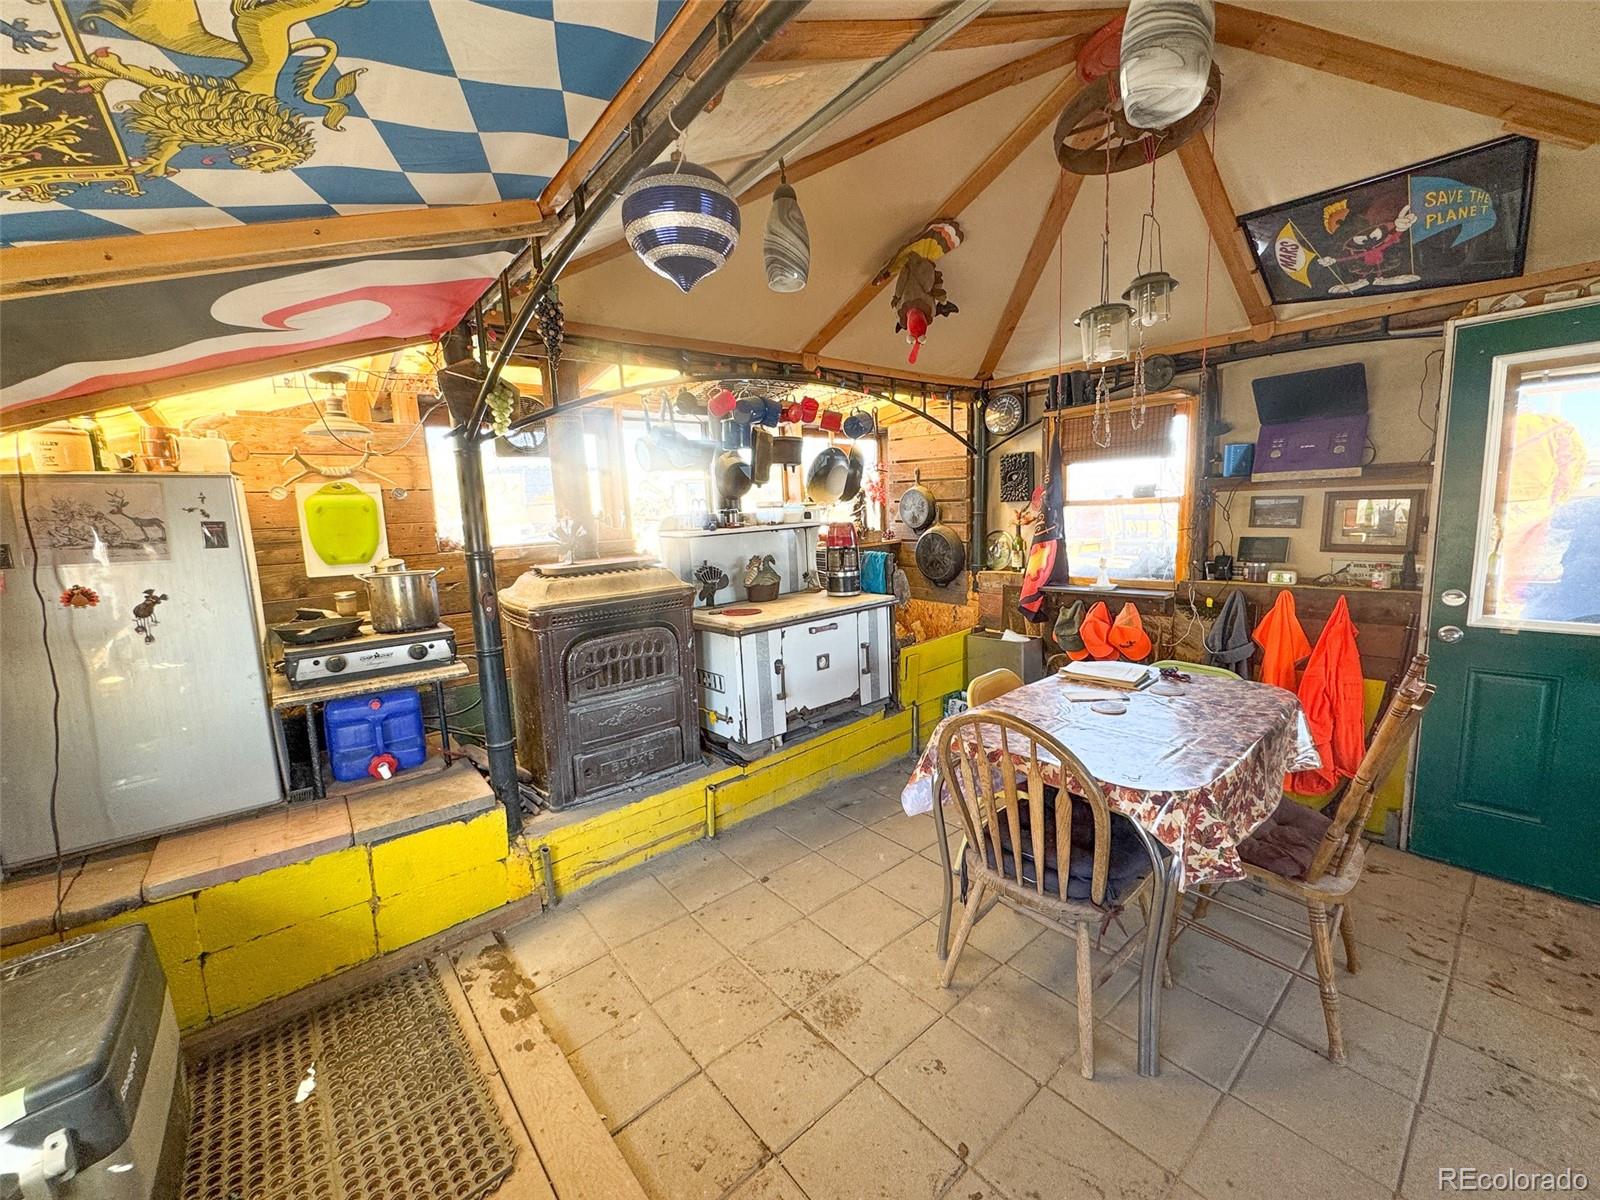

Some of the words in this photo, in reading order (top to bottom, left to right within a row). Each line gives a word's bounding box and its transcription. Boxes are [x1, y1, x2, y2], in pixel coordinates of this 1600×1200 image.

[1424, 189, 1463, 208] SAVE
[1469, 190, 1489, 204] THE
[1425, 205, 1489, 230] PLANET
[1279, 241, 1299, 272] MARS
